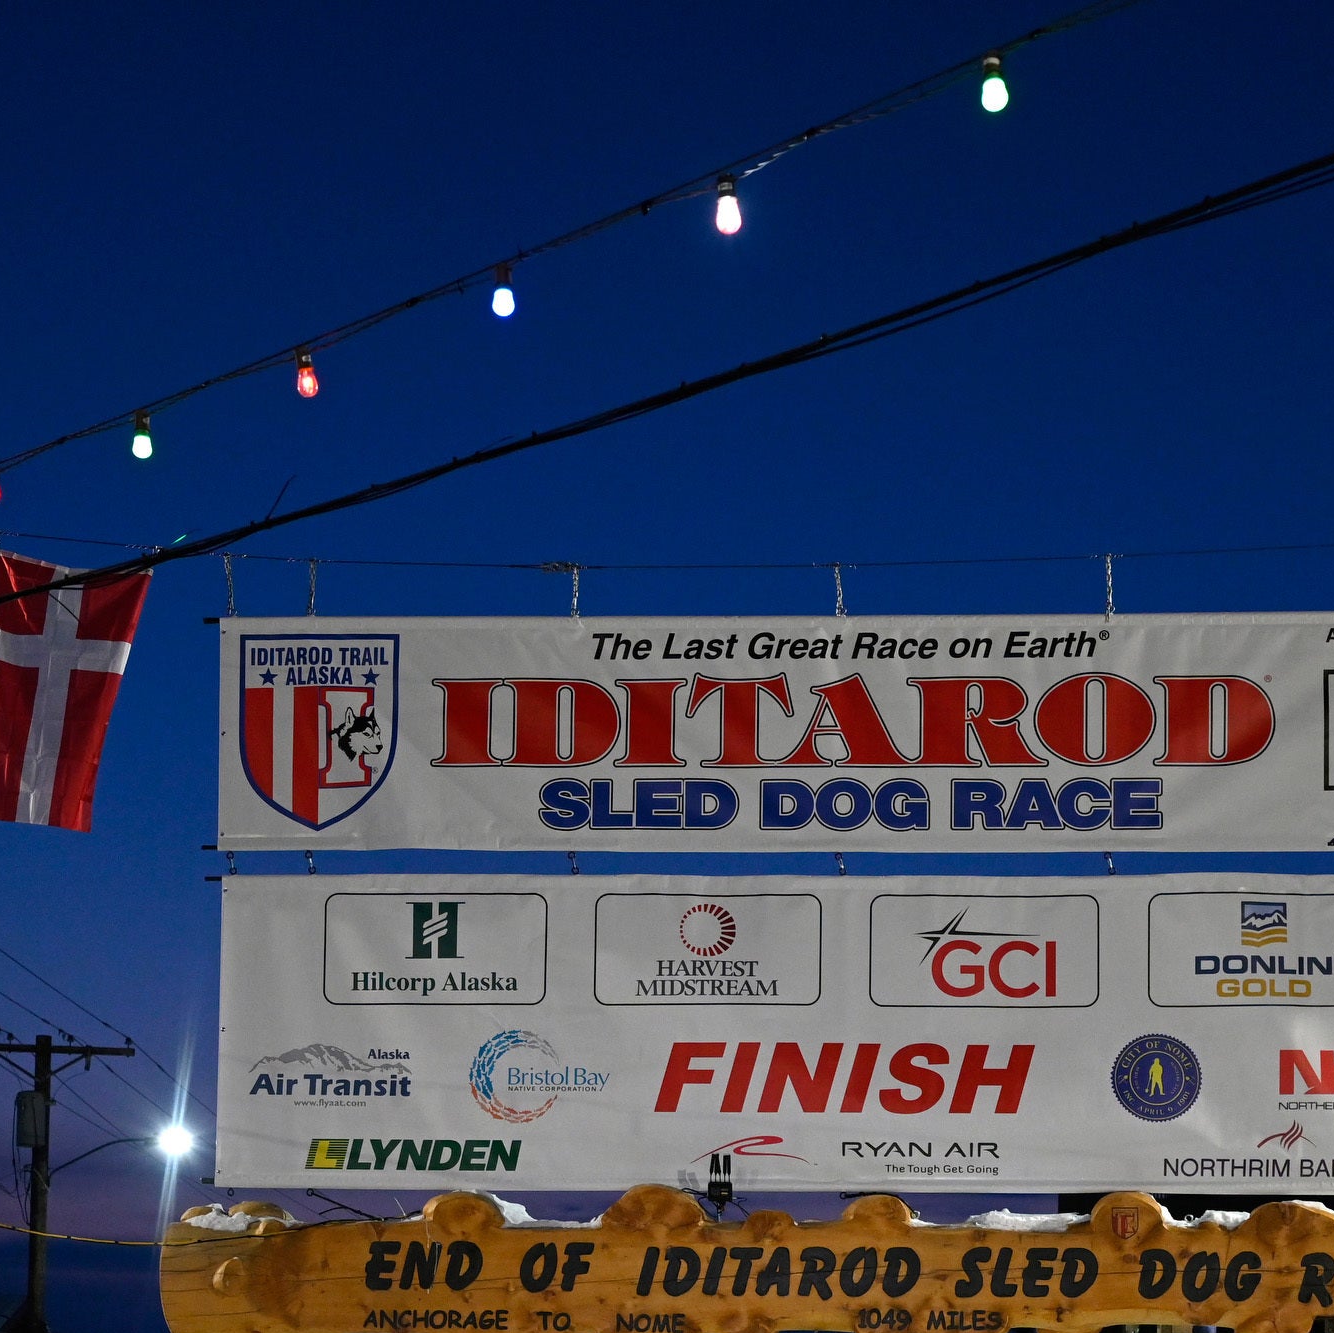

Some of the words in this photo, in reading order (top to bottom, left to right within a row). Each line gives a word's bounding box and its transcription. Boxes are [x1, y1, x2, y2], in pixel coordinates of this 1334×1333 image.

[250, 647, 334, 667] IDITAROD
[338, 647, 389, 666] TRAIL
[592, 633, 652, 661] The
[662, 632, 738, 661] Last
[747, 631, 846, 660] Great
[851, 631, 943, 660] Race
[948, 638, 996, 659] on
[286, 667, 353, 687] ALASKA
[431, 671, 1277, 769] IDITAROD
[538, 778, 739, 831] SLED
[760, 778, 930, 831] DOG
[950, 777, 1164, 831] RACE
[656, 960, 759, 979] HARVEST
[931, 940, 1057, 998] GCI
[1194, 955, 1333, 975] DONLIN
[351, 972, 436, 997] Hilcorp
[442, 972, 518, 993] Alaska
[635, 979, 779, 998] MIDSTREAM
[1215, 979, 1313, 998] GOLD
[367, 1049, 410, 1060] Alaska
[1121, 1046, 1142, 1069] CITY
[1146, 1041, 1161, 1049] OF
[1165, 1043, 1193, 1070] NOME
[249, 1073, 298, 1096] Air
[304, 1073, 411, 1097] Transit
[507, 1065, 568, 1086] Bristol
[571, 1065, 610, 1092] Bay
[654, 1041, 1035, 1115] FINISH
[294, 1098, 367, 1108] www.flyaat.com
[347, 1138, 522, 1172] LYNDEN
[842, 1141, 933, 1160] RYAN
[944, 1141, 1000, 1159] AIR
[885, 1163, 905, 1174] The
[907, 1163, 940, 1176] Tough
[943, 1164, 964, 1175] Get
[966, 1164, 999, 1176] Going
[1163, 1157, 1293, 1178] NORTHRIM
[365, 1241, 484, 1292] END
[519, 1241, 595, 1293] OF
[636, 1245, 921, 1299] IDITAROD
[954, 1246, 1098, 1299] SLED
[1138, 1247, 1262, 1302] DOG
[363, 1309, 509, 1332] ANCHORAGE
[537, 1310, 572, 1332] TO
[615, 1312, 686, 1333] NOME
[858, 1307, 911, 1331] 1049
[927, 1309, 1003, 1331] MILES
